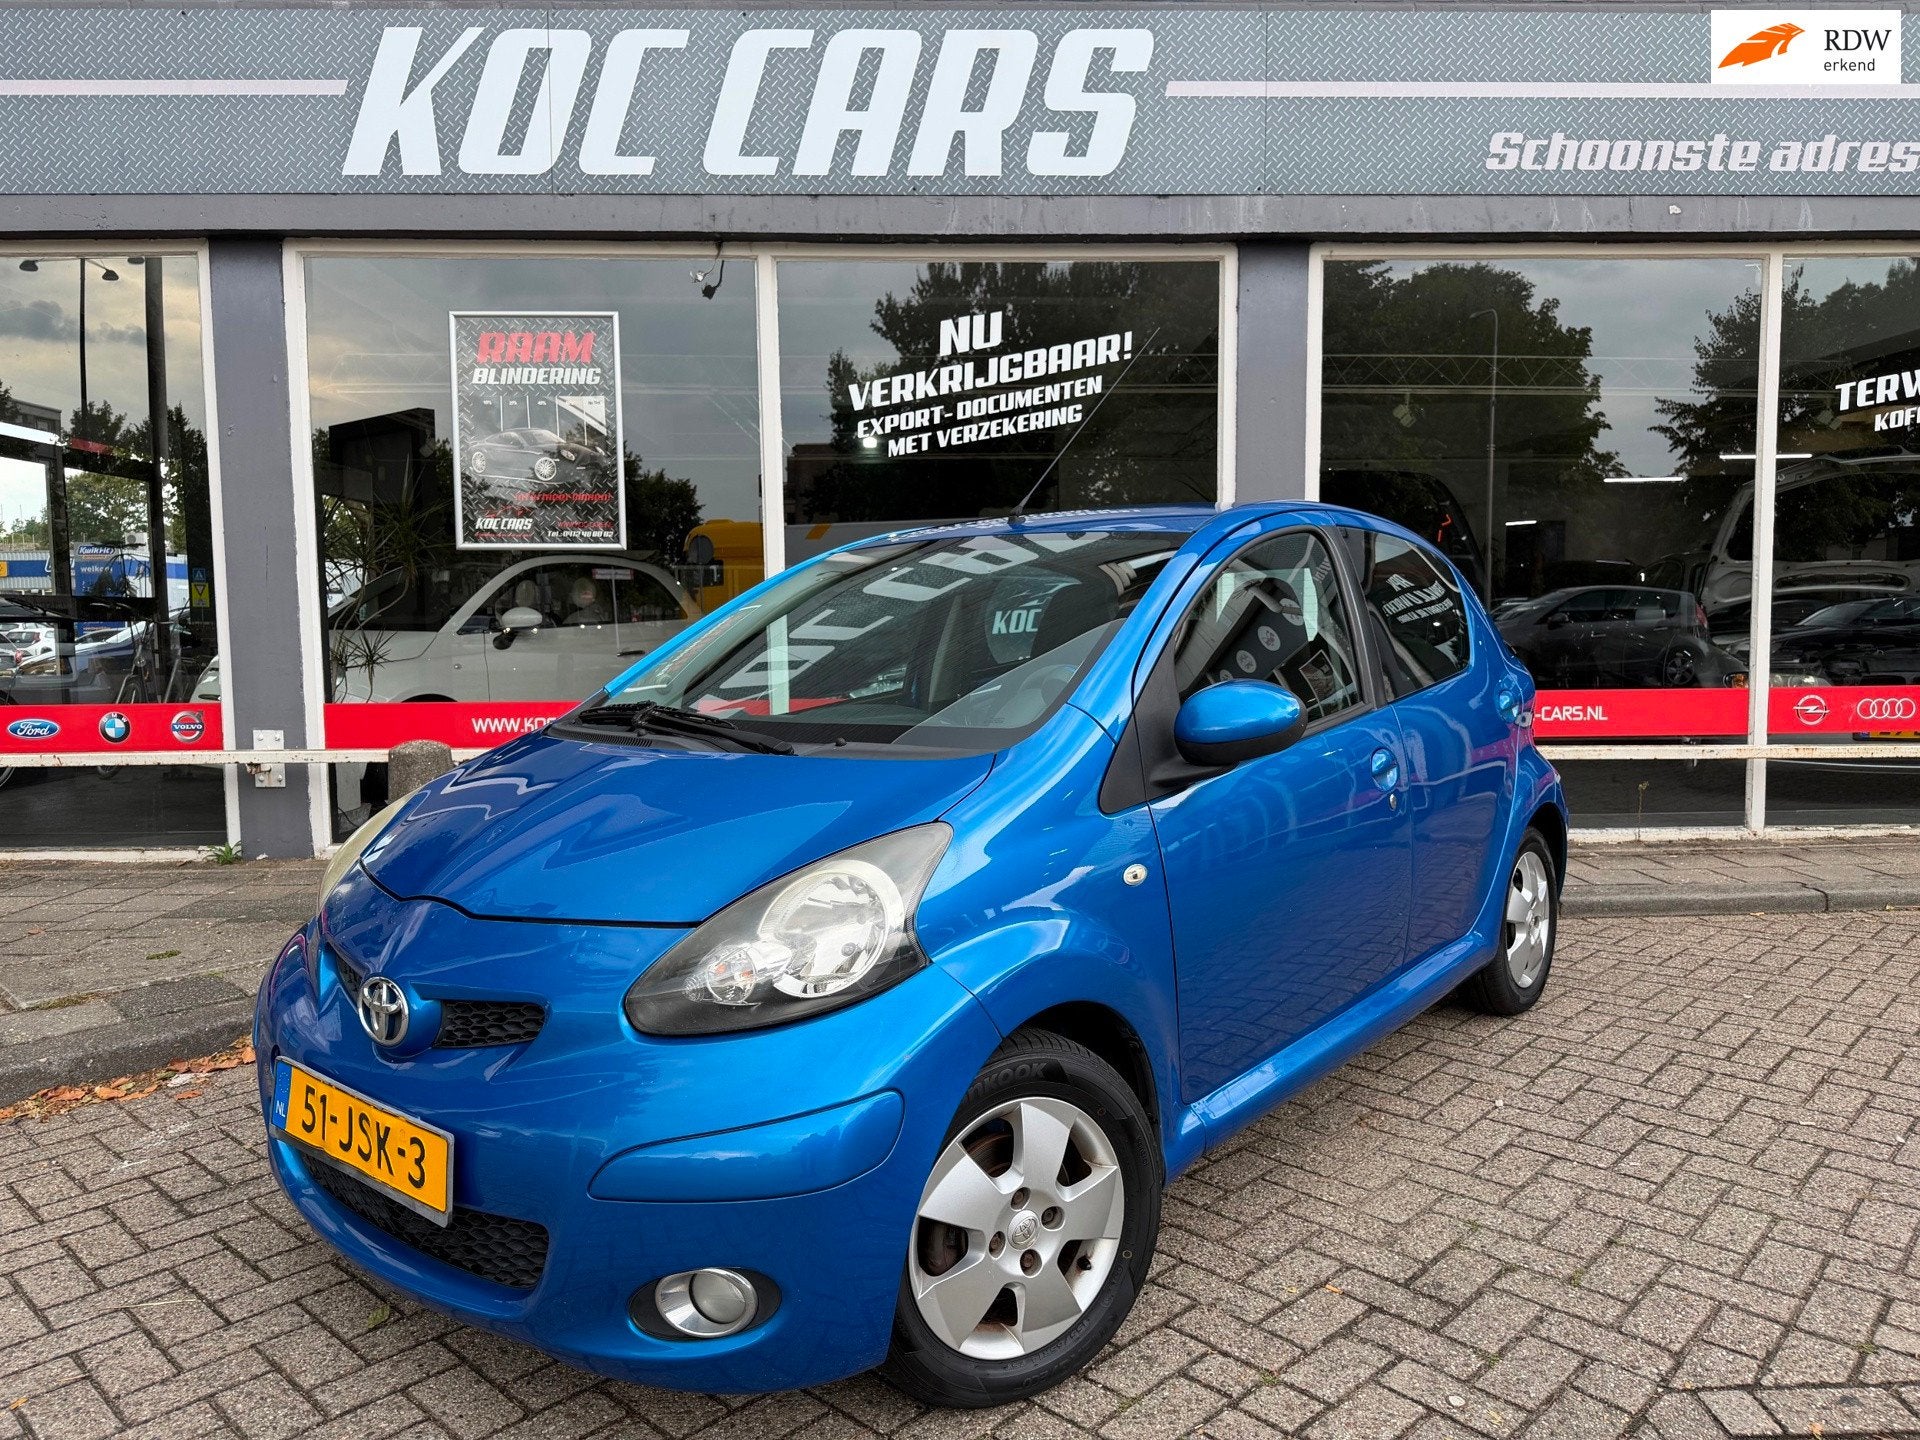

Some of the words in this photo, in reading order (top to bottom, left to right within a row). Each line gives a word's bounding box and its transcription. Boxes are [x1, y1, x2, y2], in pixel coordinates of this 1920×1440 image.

[342, 26, 690, 176] KOC
[703, 28, 1155, 177] CARS
[1485, 131, 1761, 172] Schoonste
[1769, 133, 1920, 172] adres
[476, 330, 597, 364] RAAM
[939, 310, 1003, 356] NU
[471, 367, 602, 385] BLINDERING
[848, 330, 1133, 411] VERKRIJGBAAR!
[956, 375, 1103, 420] DOCUMENTEN
[887, 432, 932, 458] MET
[936, 404, 1083, 447] VERZEKERING
[1874, 406, 1920, 432] KOF
[475, 517, 501, 530] KOC
[501, 517, 533, 530] CARS
[992, 608, 1042, 635] KOC
[16, 721, 50, 737] Ford
[275, 1100, 286, 1118] NL
[301, 1084, 426, 1189] 51-JSK-3
